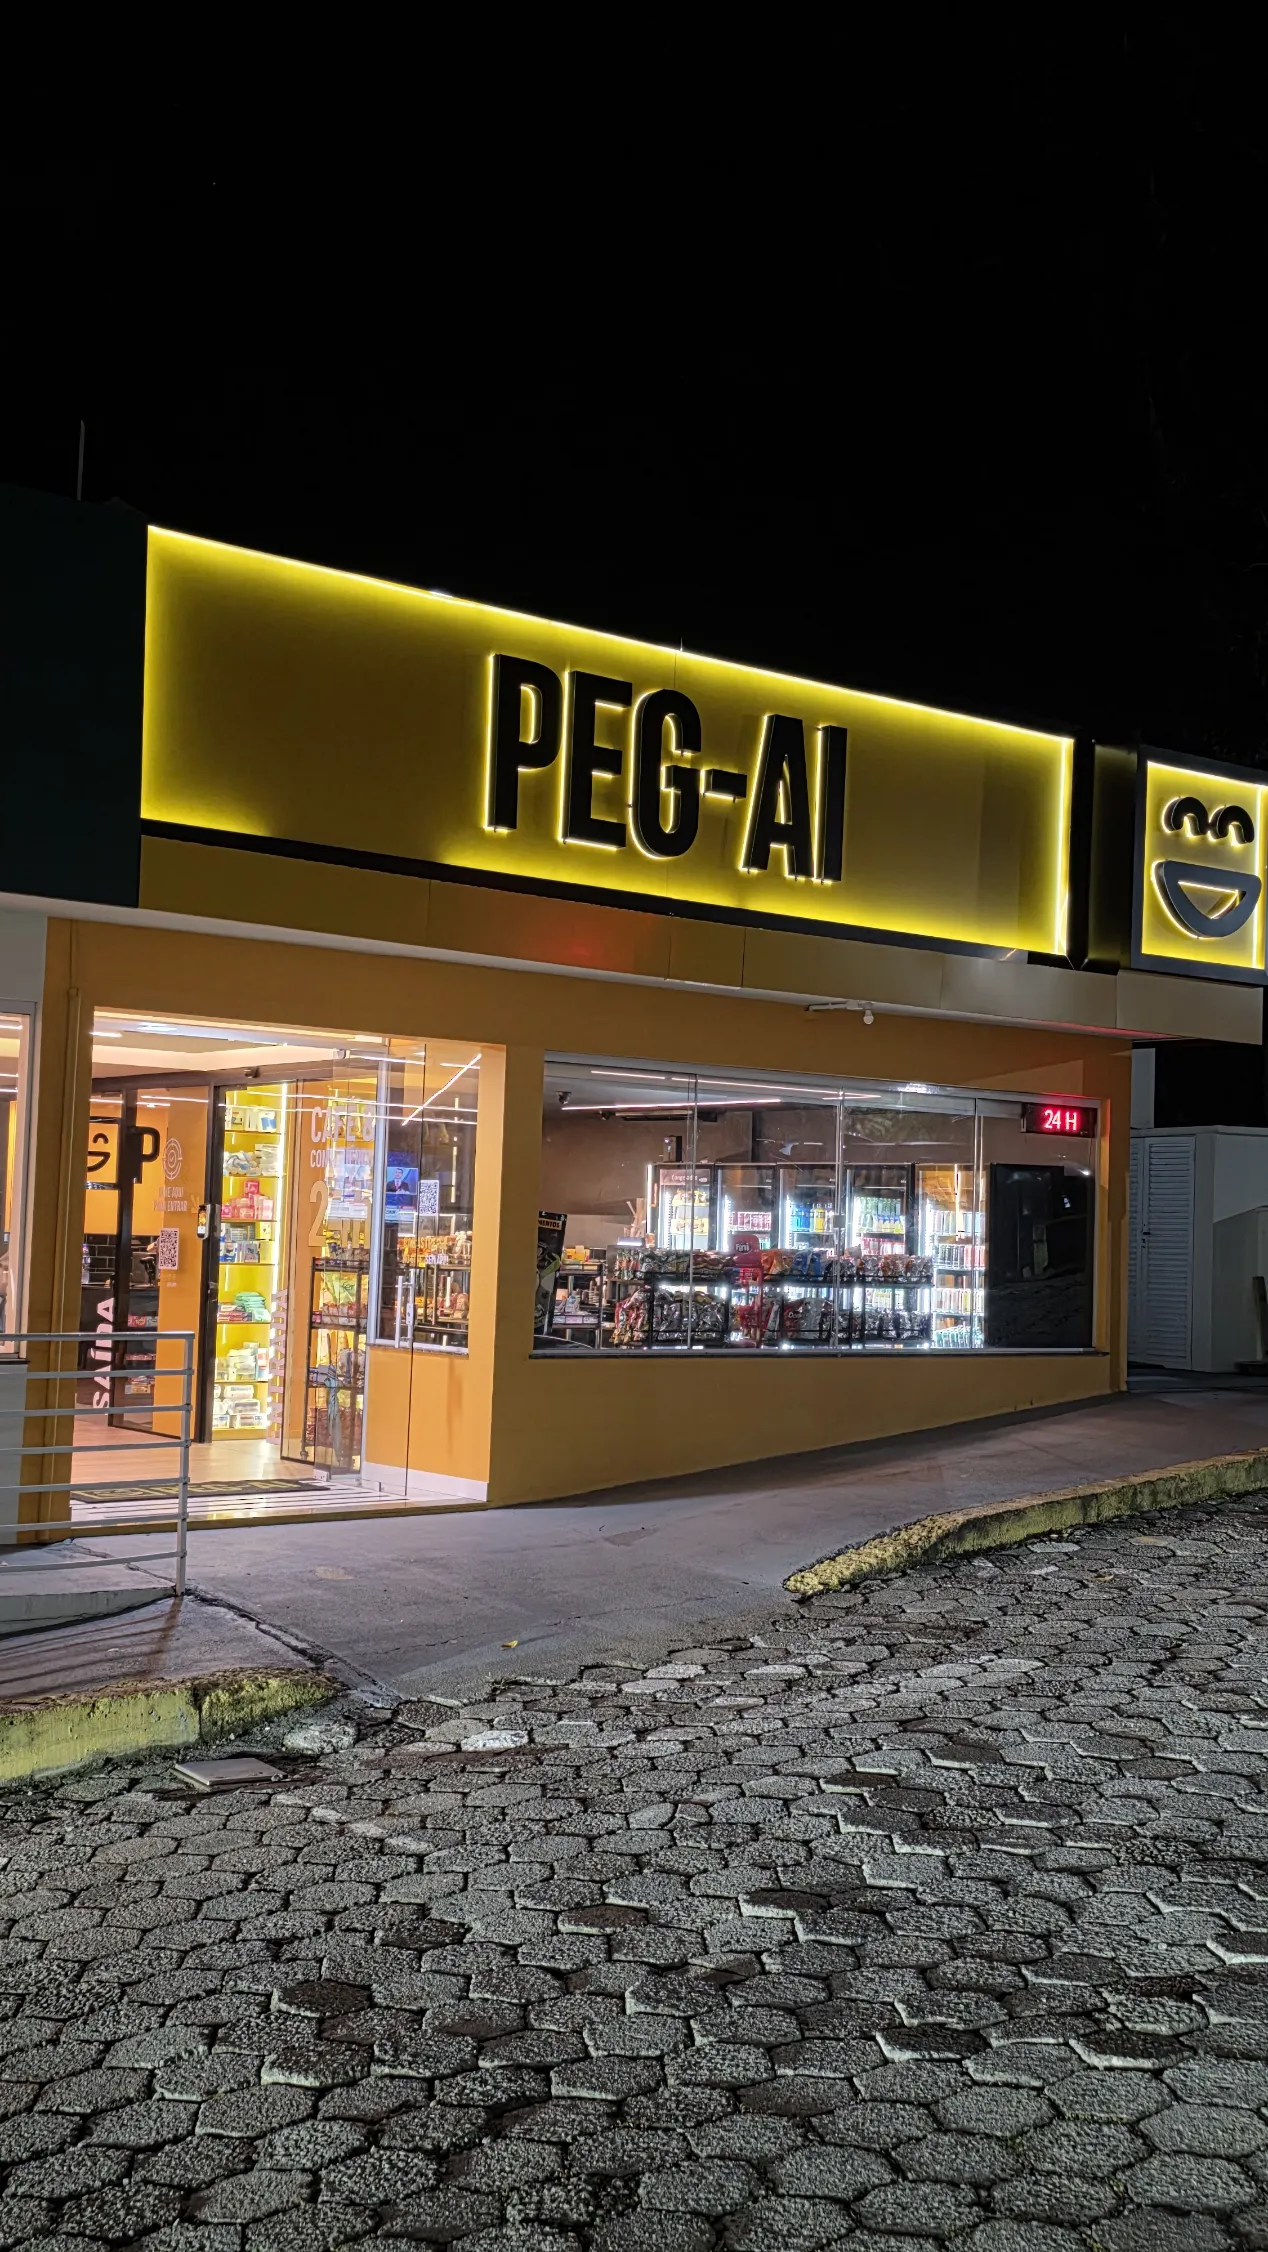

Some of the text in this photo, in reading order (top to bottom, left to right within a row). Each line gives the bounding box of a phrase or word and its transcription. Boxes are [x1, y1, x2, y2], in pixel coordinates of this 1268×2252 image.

[485, 653, 848, 884] PEG-AI
[310, 1096, 357, 1143] CAFÉ
[1043, 1109, 1078, 1131] 24 H
[735, 1243, 750, 1252] Fini
[92, 1298, 115, 1415] SAÍDA
[265, 1289, 288, 1445] ENTRADA
